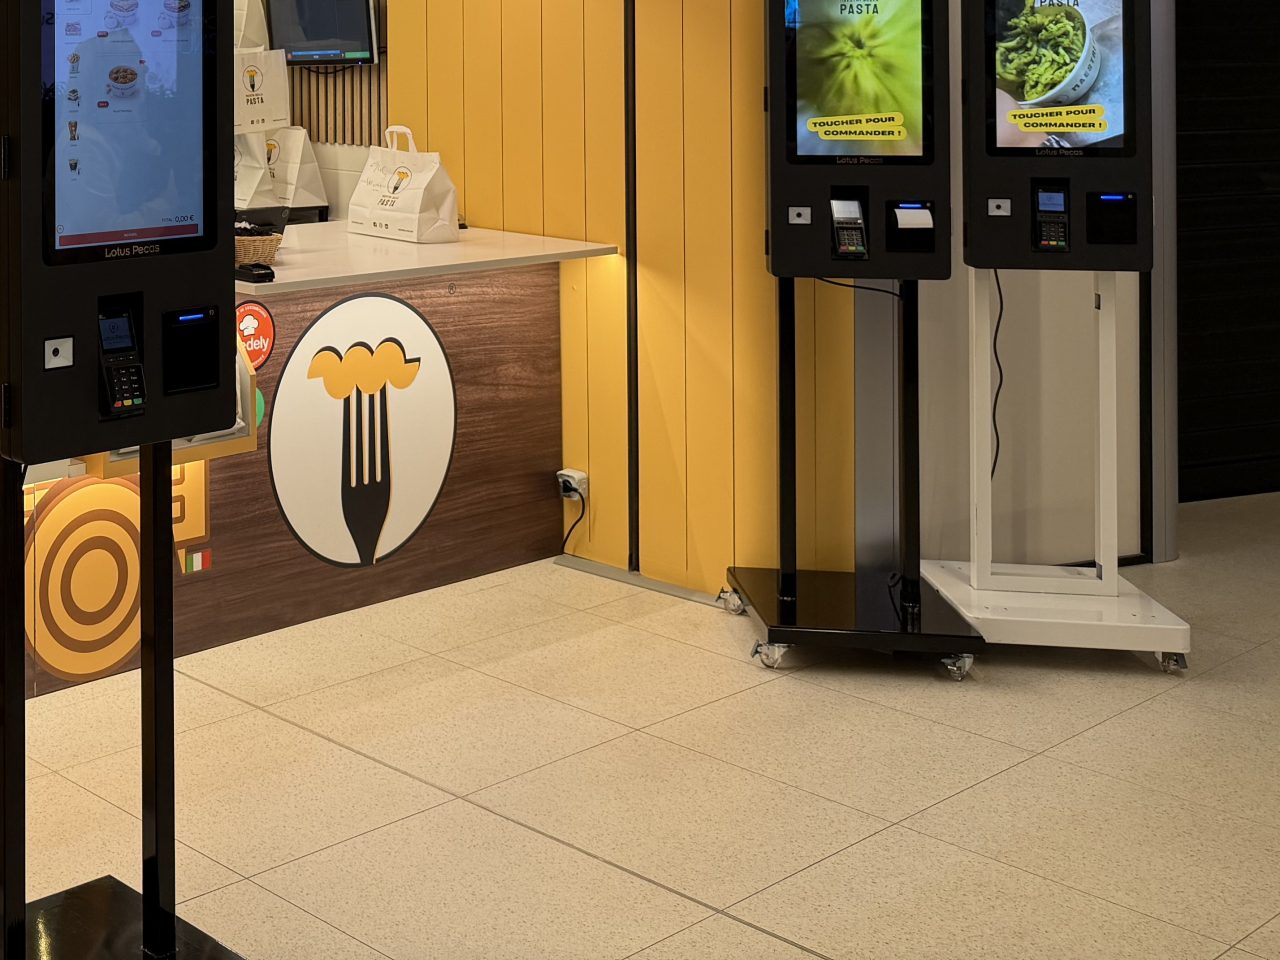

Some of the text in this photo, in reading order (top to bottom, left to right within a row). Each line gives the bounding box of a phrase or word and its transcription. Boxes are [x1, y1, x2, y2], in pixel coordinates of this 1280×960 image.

[840, 4, 879, 15] PASTA
[246, 97, 265, 106] PASTA
[1011, 108, 1096, 119] TOUCHER POUR
[812, 116, 895, 128] TOUCHER POUR
[1023, 121, 1096, 129] COMMANDER
[105, 244, 160, 258] Lotus Pecas
